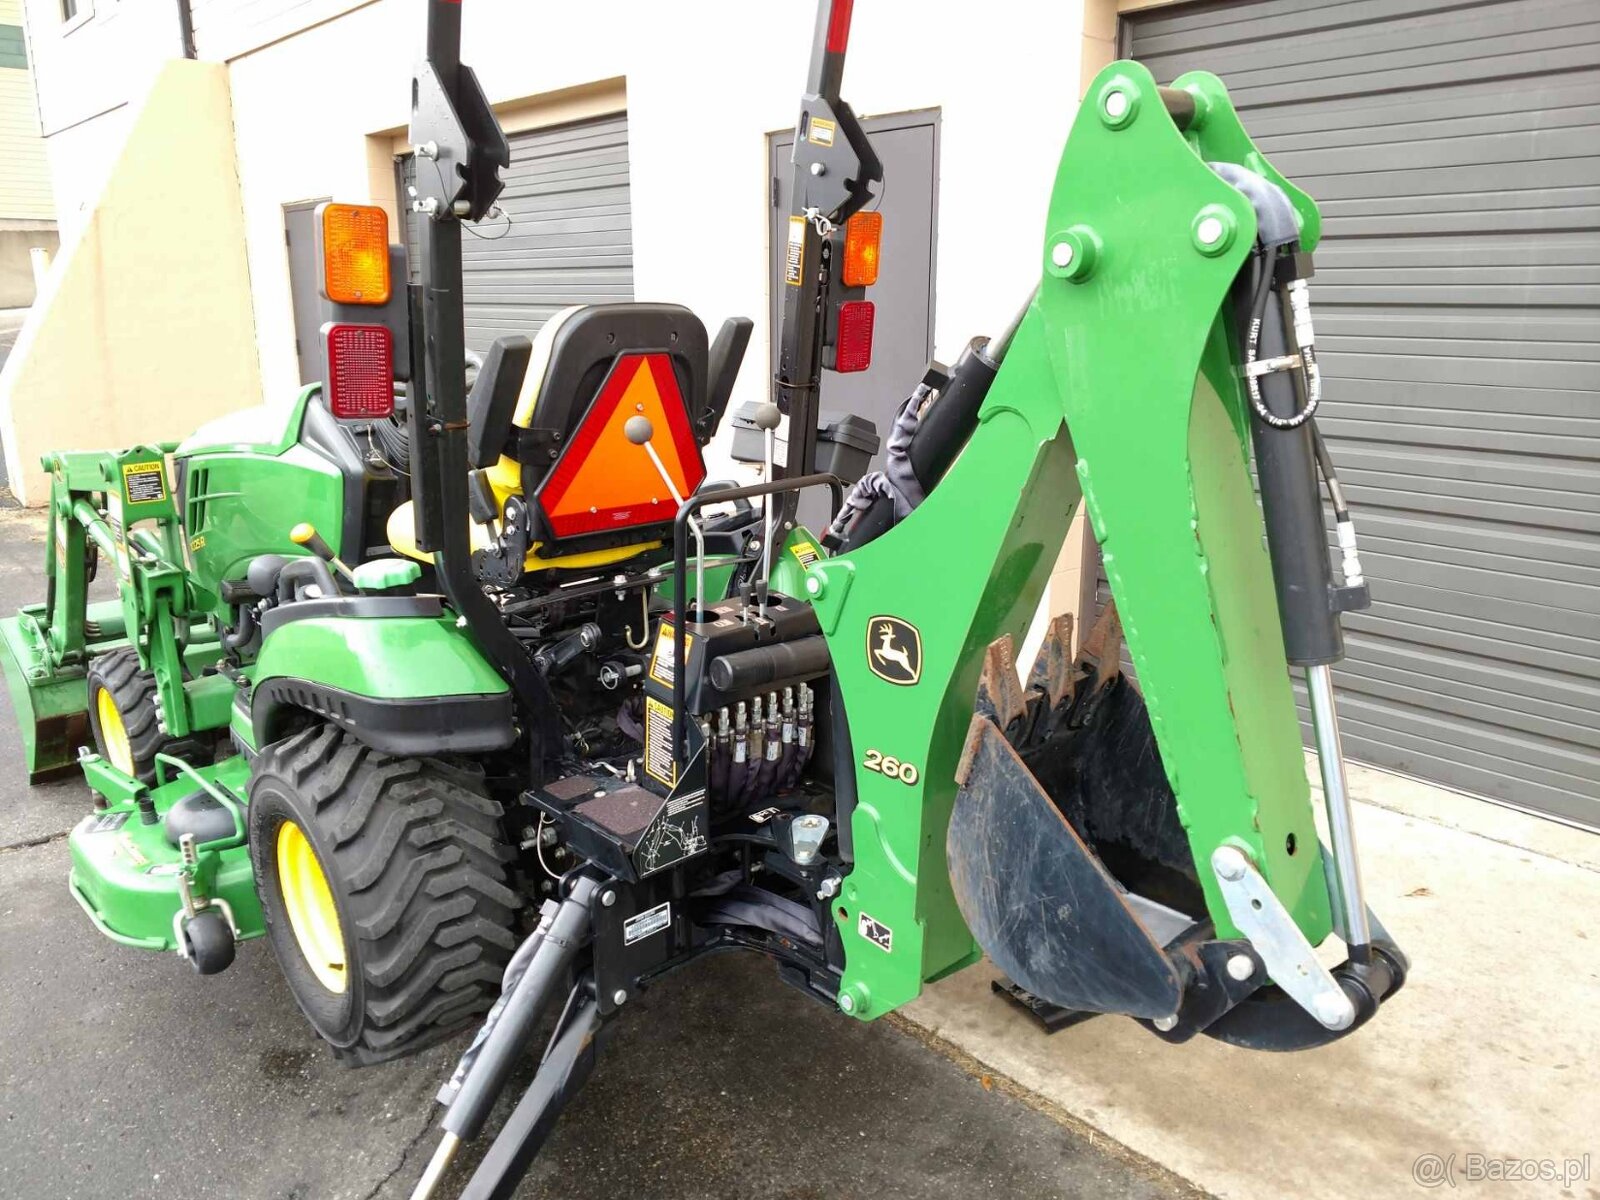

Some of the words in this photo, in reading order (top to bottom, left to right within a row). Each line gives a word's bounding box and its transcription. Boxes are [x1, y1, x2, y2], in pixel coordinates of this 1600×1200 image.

[1249, 318, 1261, 345] KURT
[133, 463, 160, 472] CAUTION
[863, 749, 920, 786] 260
